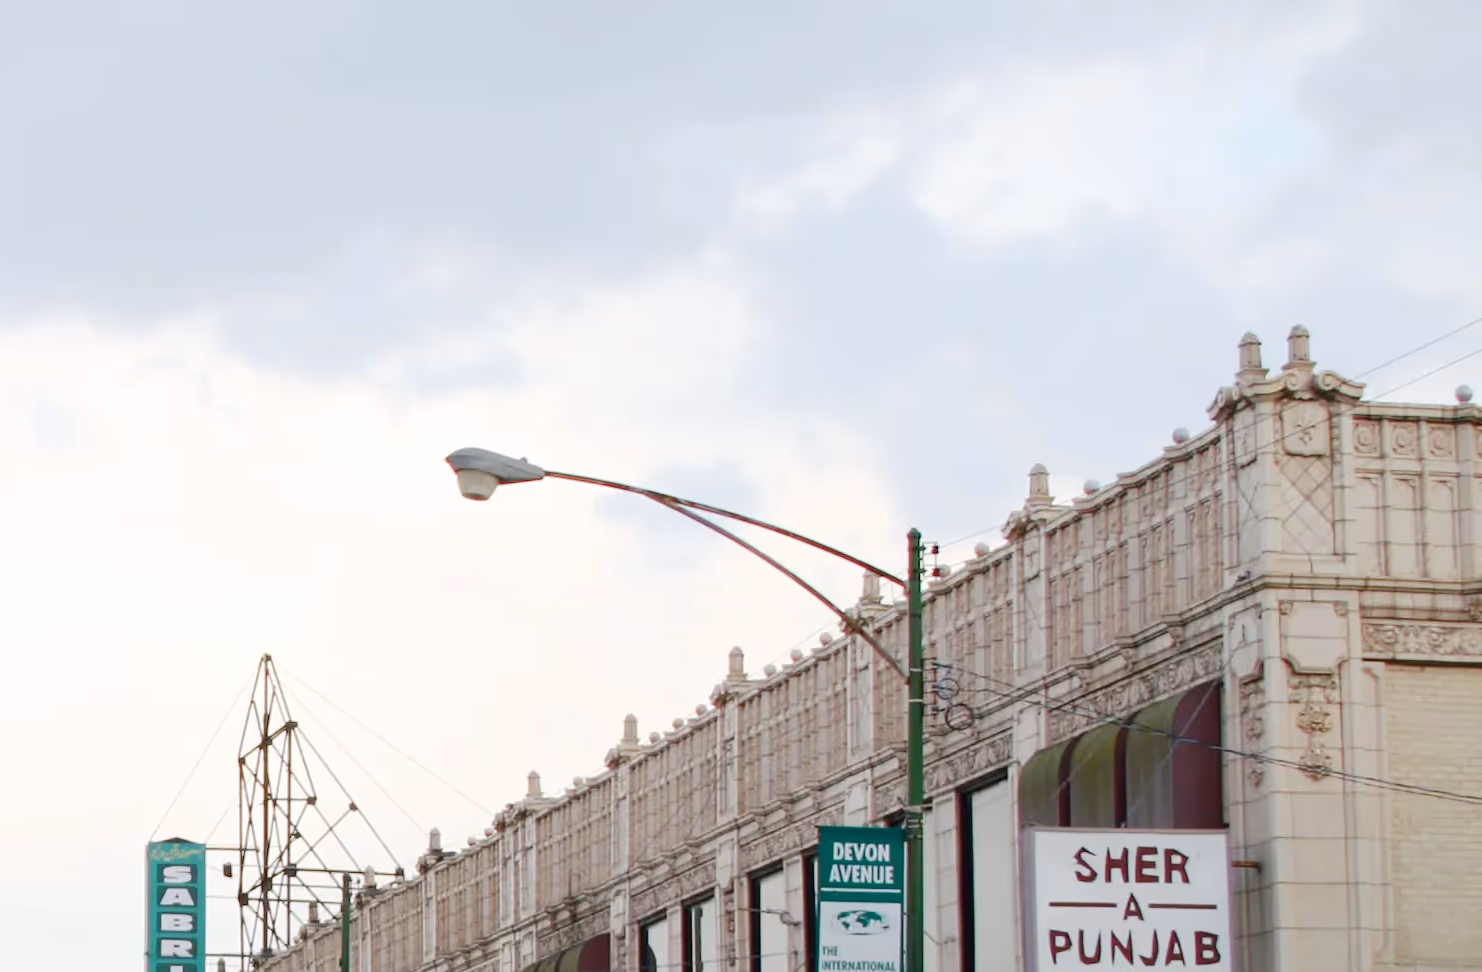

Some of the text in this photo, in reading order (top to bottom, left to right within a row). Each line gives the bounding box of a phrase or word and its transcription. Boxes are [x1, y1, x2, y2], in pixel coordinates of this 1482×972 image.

[832, 841, 891, 862] DEVON
[829, 864, 895, 885] AVENUE
[1073, 846, 1191, 884] SHER
[1123, 892, 1145, 921] A
[821, 946, 839, 956] THE
[1048, 929, 1222, 967] PUNJAB
[821, 961, 897, 972] INTERNATIONAL
